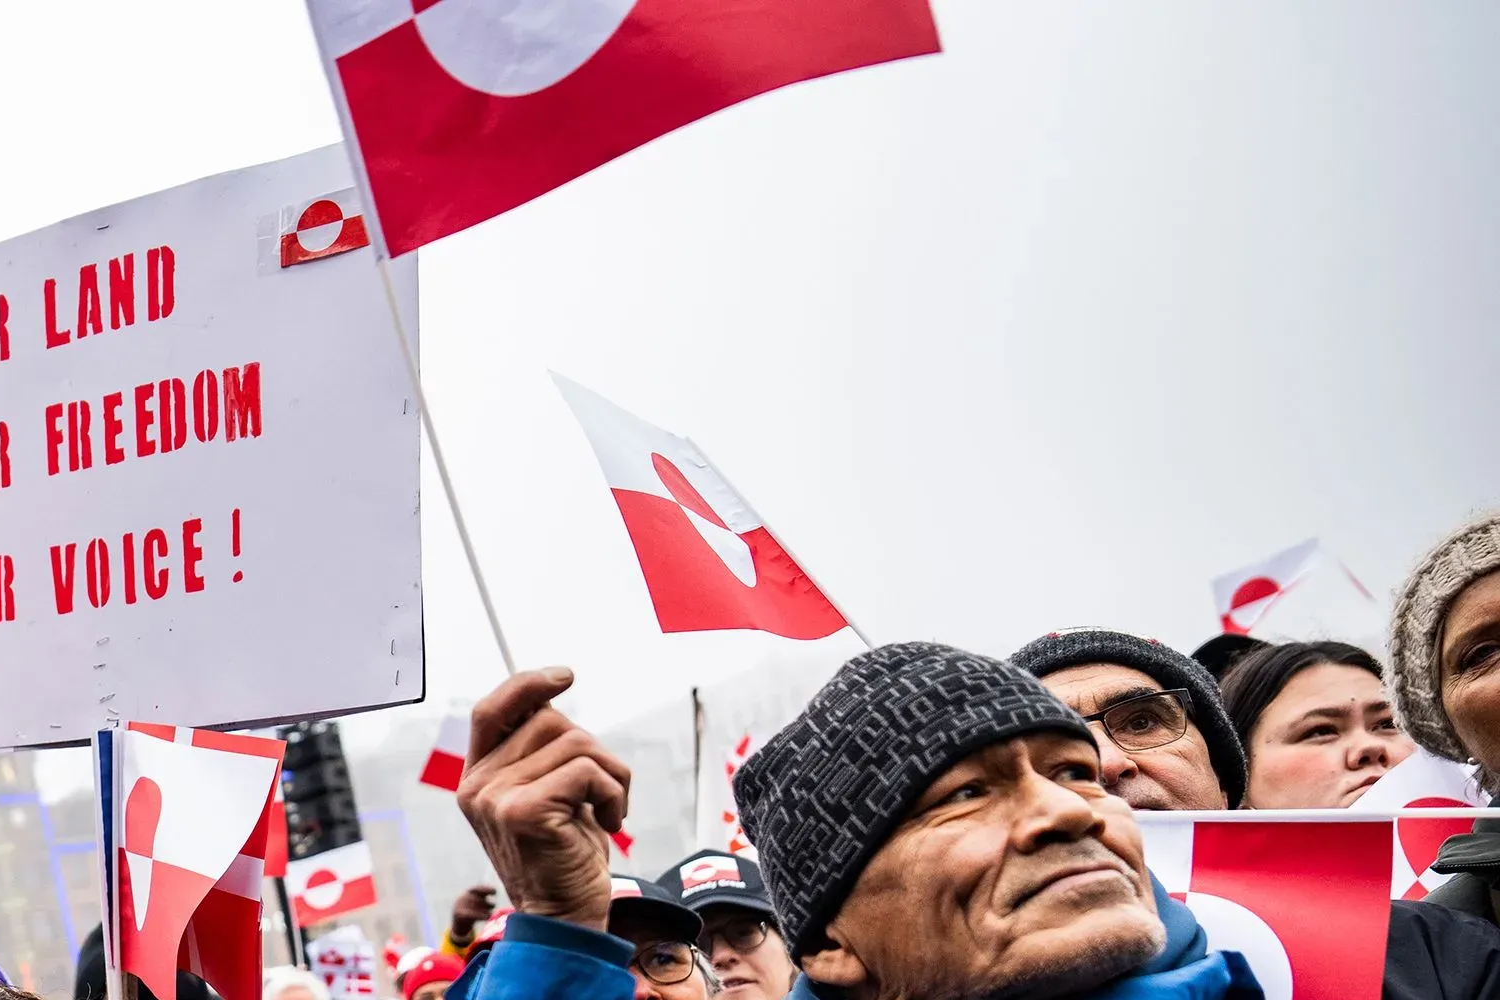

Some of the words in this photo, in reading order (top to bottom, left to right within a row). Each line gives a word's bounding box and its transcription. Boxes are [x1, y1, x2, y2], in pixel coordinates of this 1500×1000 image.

[43, 244, 177, 349] LAND
[45, 361, 263, 477] FREEDOM
[49, 518, 206, 615] VOICE
[232, 508, 244, 583] !
